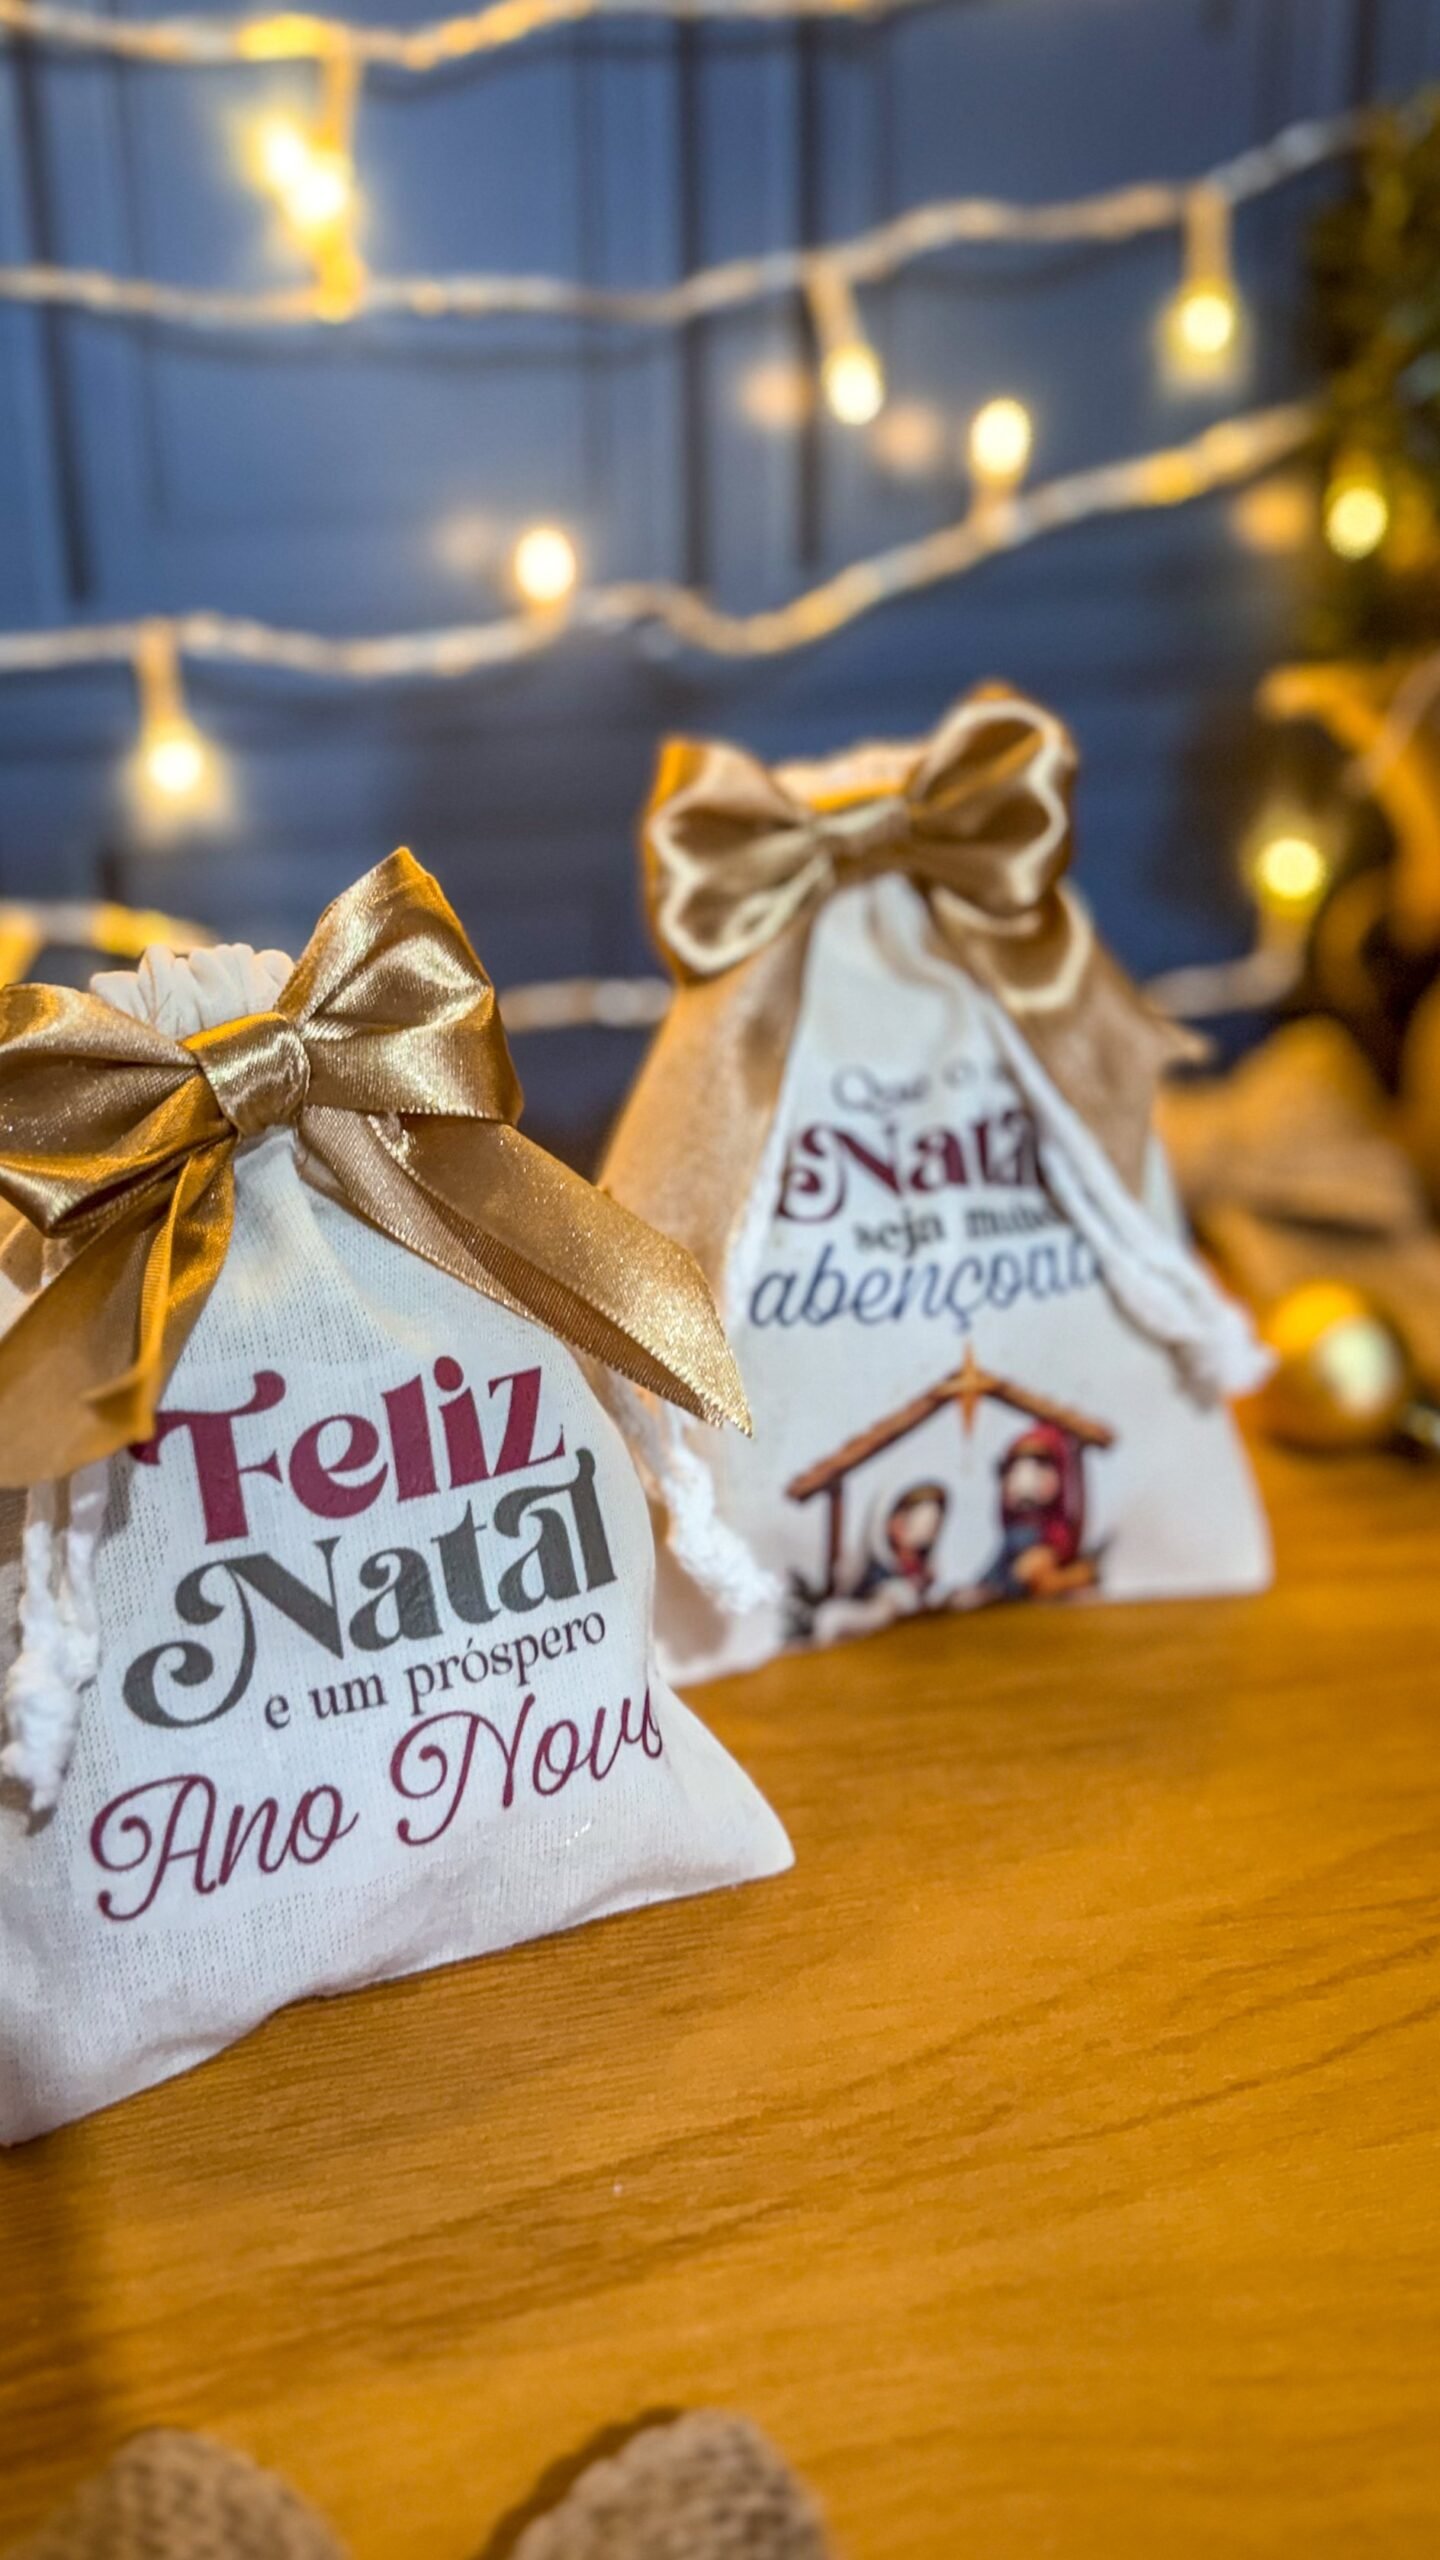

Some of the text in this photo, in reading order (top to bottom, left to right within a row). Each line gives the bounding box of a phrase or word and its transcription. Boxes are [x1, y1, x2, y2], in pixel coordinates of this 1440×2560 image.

[775, 1107, 1041, 1224] Nata
[128, 1355, 566, 1545] Feliz
[121, 1447, 618, 1729] Natal
[264, 1610, 607, 1732] e um próspero
[89, 1773, 360, 1922] Ano
